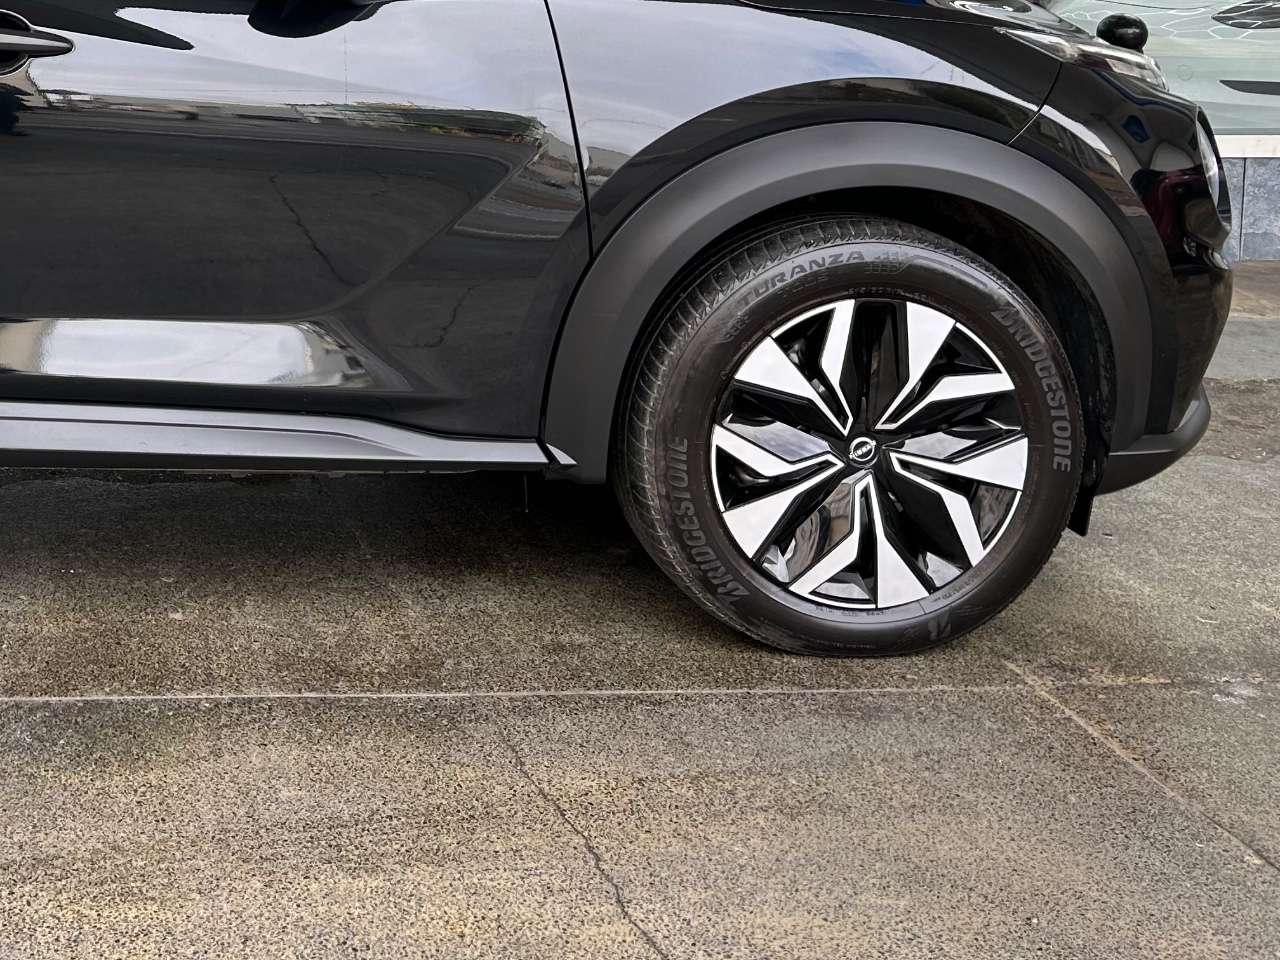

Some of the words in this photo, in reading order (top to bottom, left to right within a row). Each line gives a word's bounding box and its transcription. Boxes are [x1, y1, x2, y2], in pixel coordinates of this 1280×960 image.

[736, 250, 866, 307] TURANZA
[990, 296, 1072, 472] BRIDGESTONE
[668, 436, 752, 607] BRIDGESTONE
